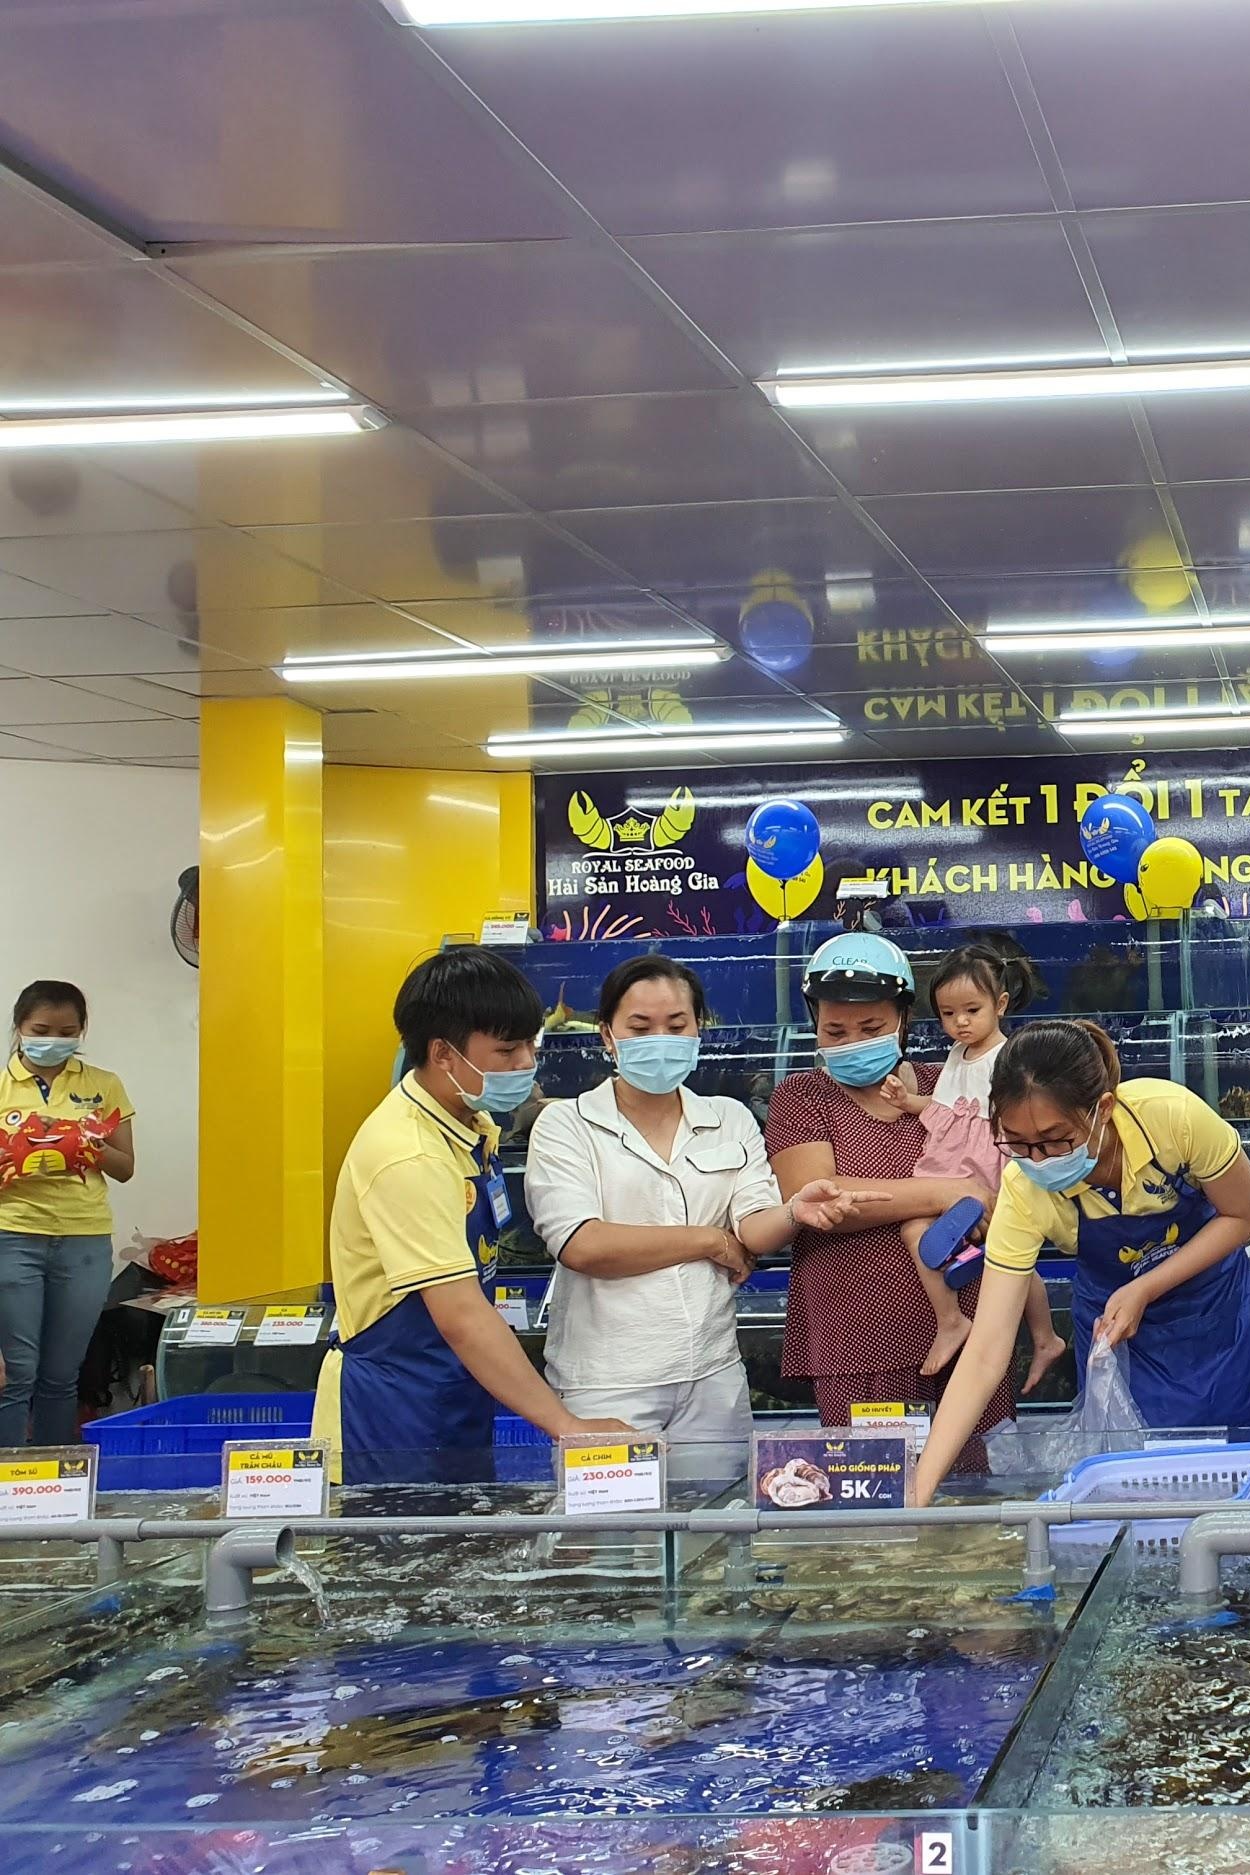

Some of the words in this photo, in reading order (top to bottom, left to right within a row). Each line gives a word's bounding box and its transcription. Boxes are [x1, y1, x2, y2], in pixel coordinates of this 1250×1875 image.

[867, 800, 950, 830] CAM
[962, 783, 1031, 826] KẾT
[1039, 784, 1059, 824] 1
[1185, 778, 1203, 818] 1
[571, 859, 621, 874] ROYAL
[624, 857, 695, 872] SEAFOOD
[1009, 853, 1117, 890] HÀNG
[548, 877, 578, 896] Hải
[584, 876, 619, 895] Sản
[625, 874, 683, 896] Hoàng
[688, 872, 720, 891] Gia
[582, 1469, 633, 1481] 230.000
[878, 1462, 901, 1472] PHÁP
[245, 1475, 292, 1484] 159.000
[12, 1485, 62, 1495] 390.000
[928, 1841, 947, 1867] 2
